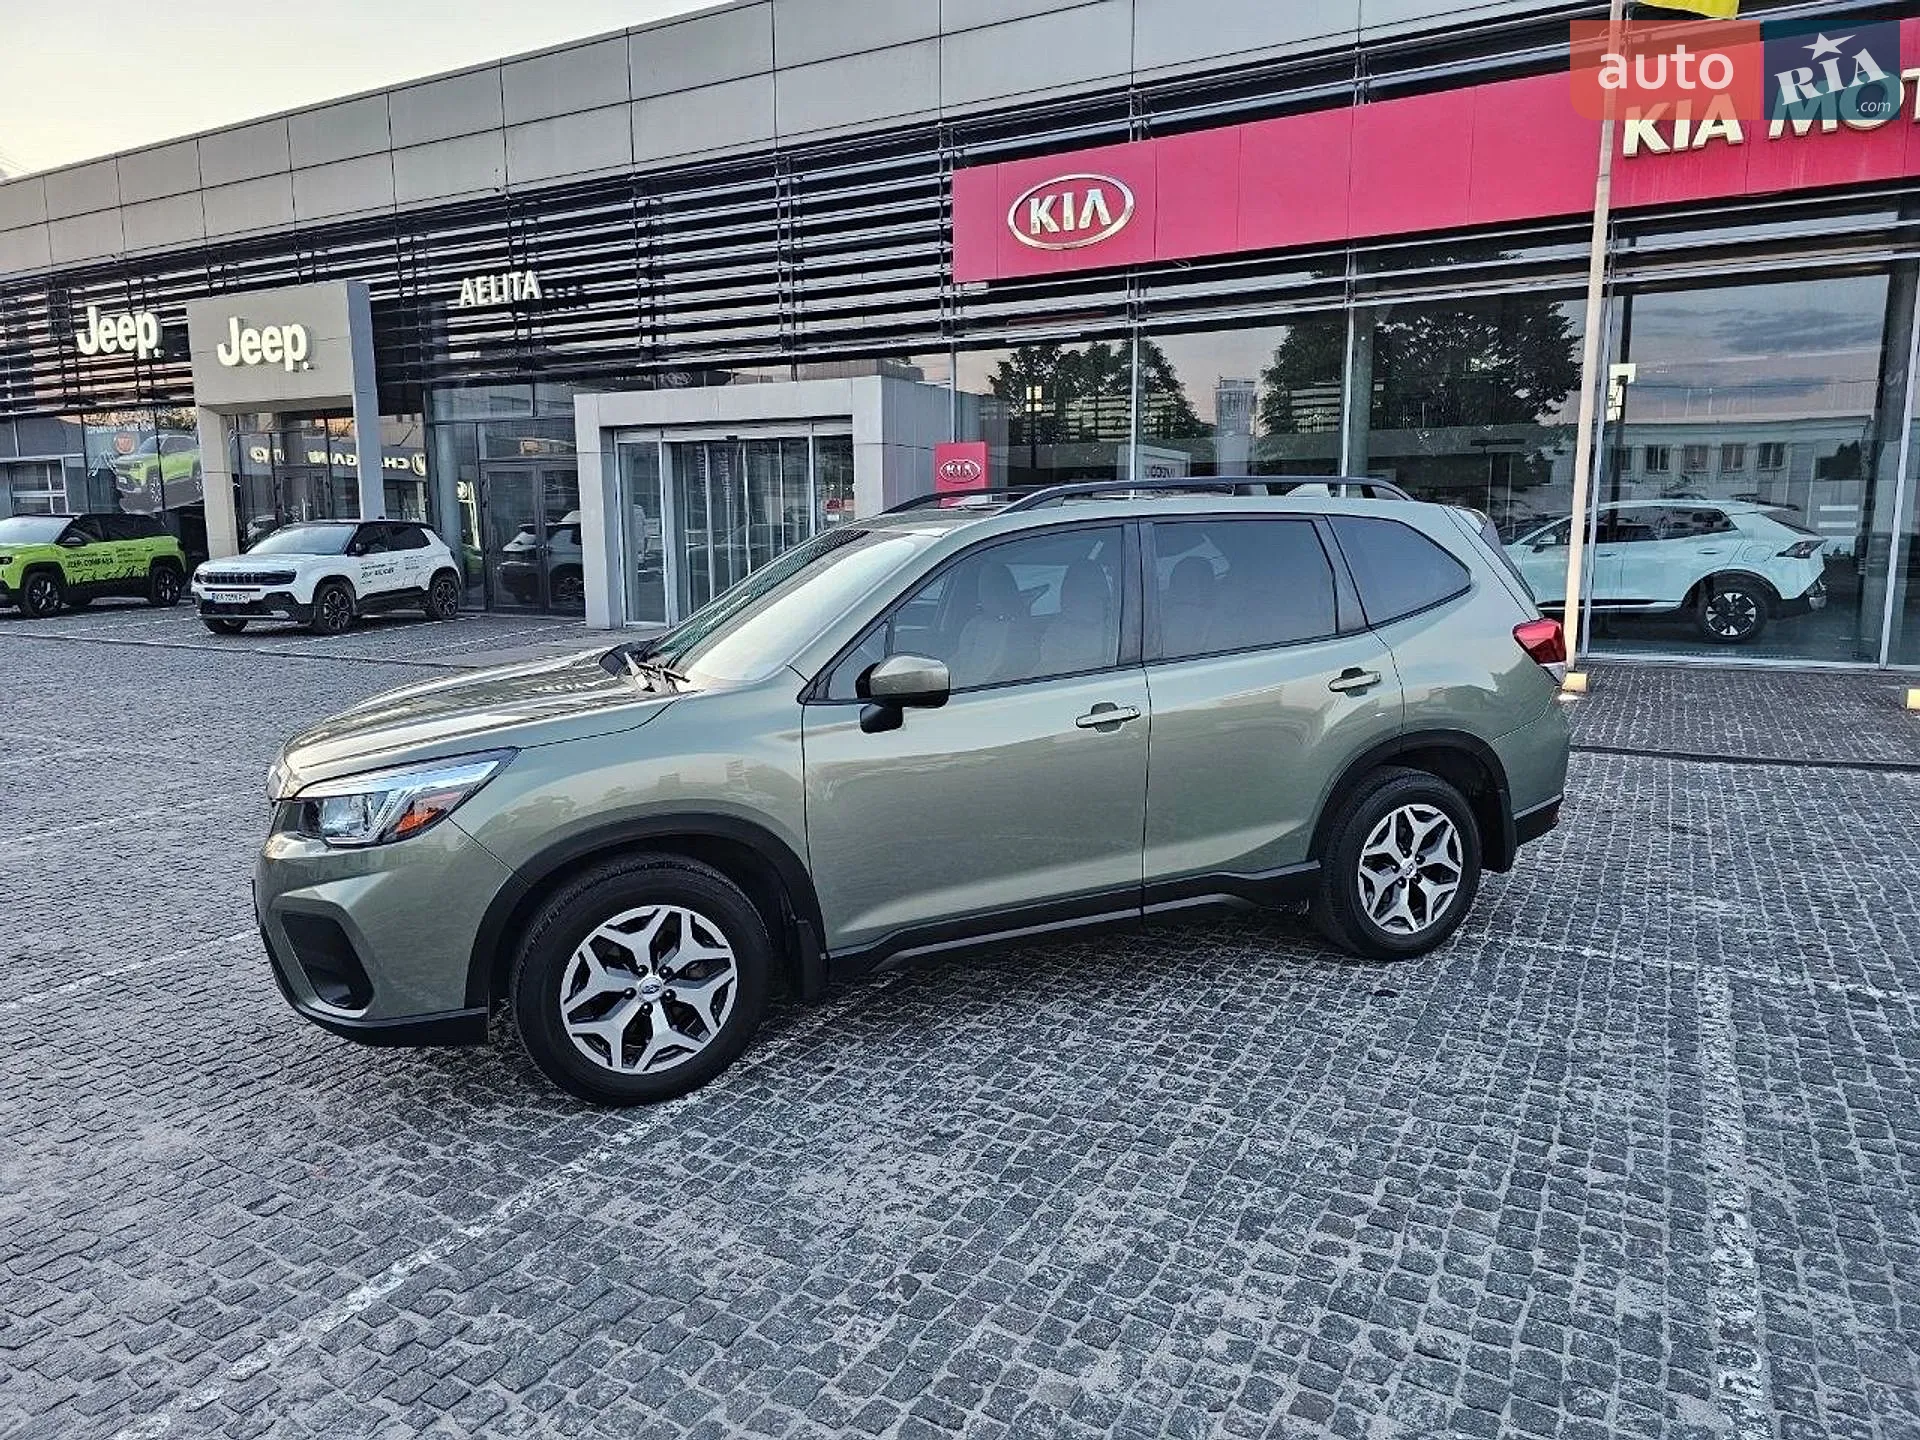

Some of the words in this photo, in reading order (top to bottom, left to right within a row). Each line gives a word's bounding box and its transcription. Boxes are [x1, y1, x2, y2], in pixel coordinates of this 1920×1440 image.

[1622, 93, 1745, 158] KIA
[1028, 188, 1113, 235] KIA
[459, 270, 543, 308] AELITA
[76, 305, 162, 360] Jeep
[217, 316, 308, 372] Jeep
[946, 463, 975, 477] KIA
